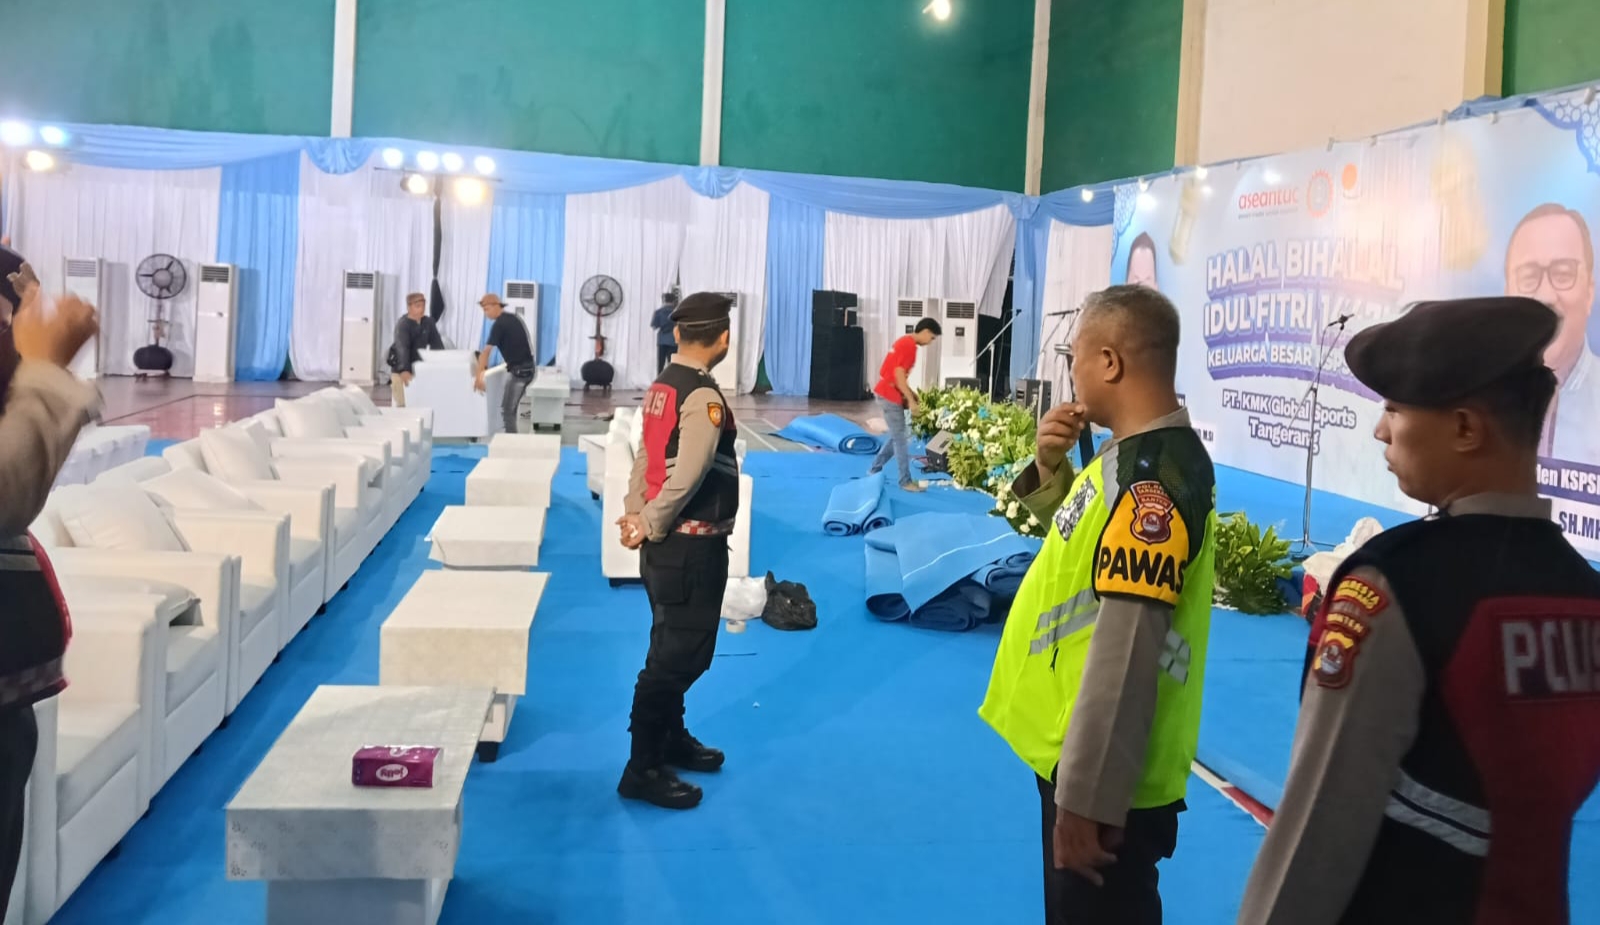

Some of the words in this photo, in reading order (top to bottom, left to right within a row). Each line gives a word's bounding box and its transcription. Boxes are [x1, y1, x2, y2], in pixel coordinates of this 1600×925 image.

[1207, 241, 1280, 291] HALAL
[1205, 296, 1252, 337] IDUL
[1257, 292, 1312, 329] FITRI
[1208, 344, 1268, 368] KELUARGA
[1270, 343, 1312, 365] BESAR
[1222, 388, 1241, 407] PT.
[1241, 392, 1269, 413] KMK
[1272, 397, 1310, 421] Global
[1315, 403, 1357, 428] Sports
[1249, 418, 1320, 454] Tangerang
[1097, 546, 1187, 594] PAWAS
